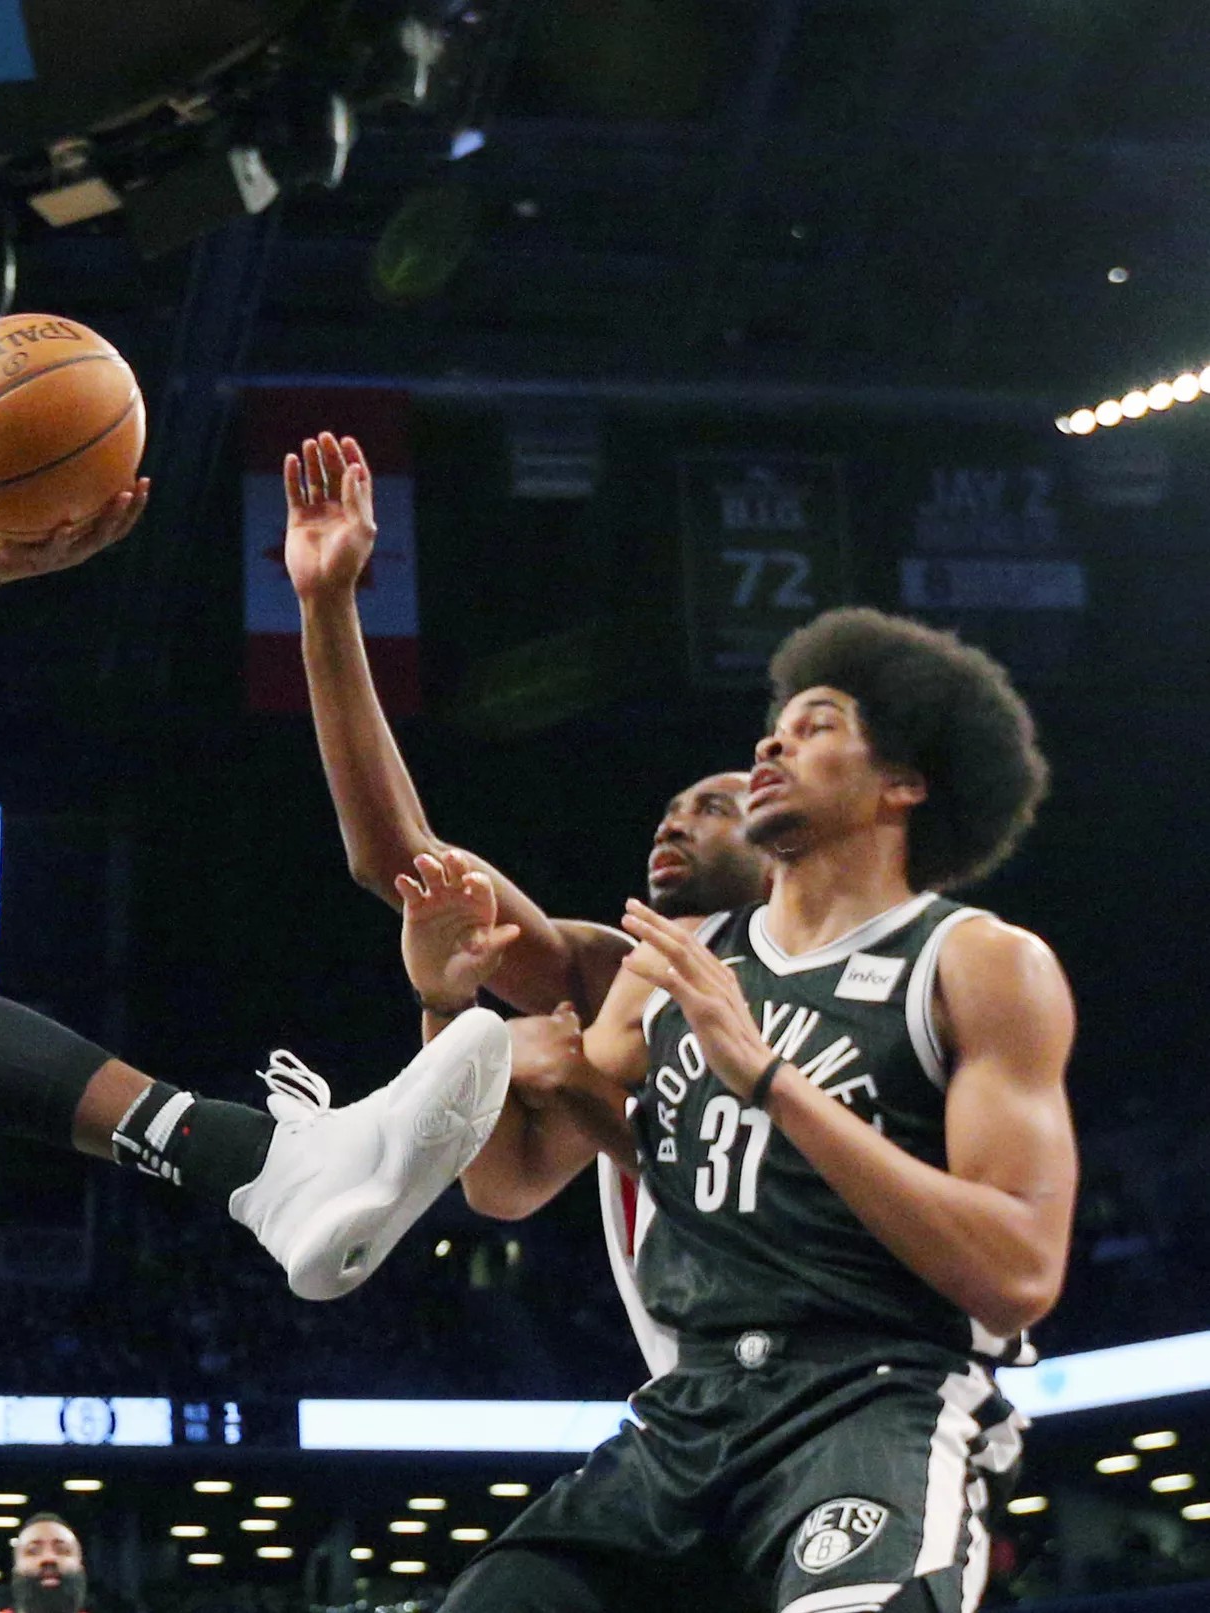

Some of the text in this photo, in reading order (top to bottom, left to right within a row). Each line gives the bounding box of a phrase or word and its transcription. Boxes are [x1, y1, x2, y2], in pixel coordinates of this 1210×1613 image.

[721, 549, 815, 608] 72
[847, 966, 891, 985] infor
[656, 1000, 821, 1163] BROOYN
[798, 1502, 880, 1545] NETS
[816, 1535, 833, 1561] B
